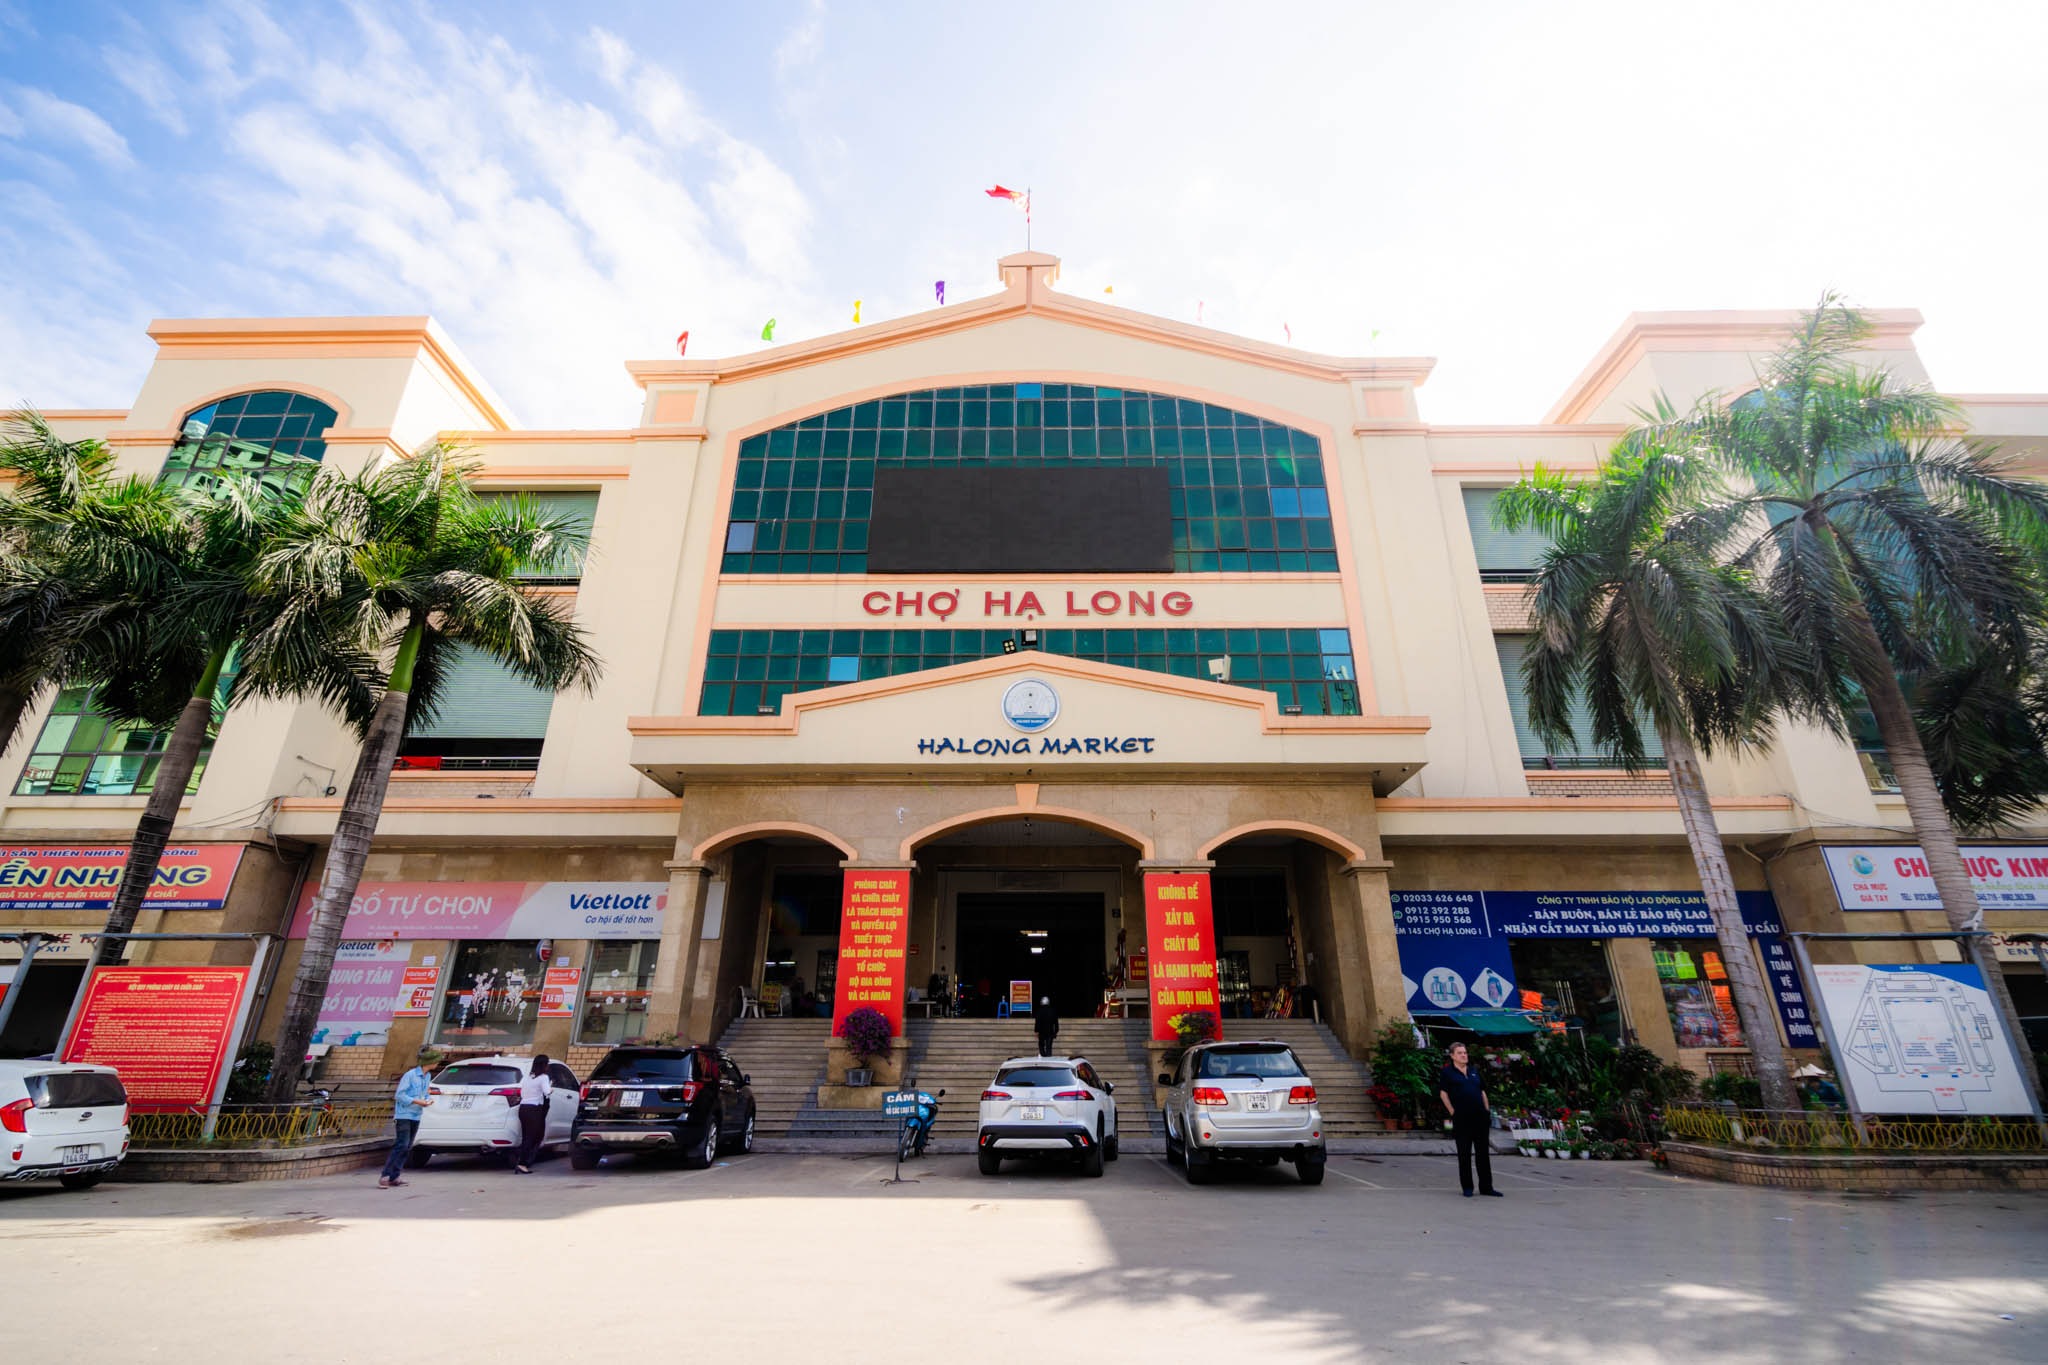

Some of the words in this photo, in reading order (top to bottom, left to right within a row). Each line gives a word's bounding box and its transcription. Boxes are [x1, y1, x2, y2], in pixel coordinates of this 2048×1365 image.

[862, 588, 960, 622] CHỢ
[984, 590, 1046, 621] HẠ
[1066, 590, 1193, 617] LONG
[917, 737, 1031, 755] HALONG
[1040, 737, 1155, 755] MARKET
[42, 848, 80, 857] THIÊN
[82, 848, 126, 857] NHIÊN
[53, 864, 212, 888] NHNG
[1893, 857, 1933, 878] CH
[1962, 855, 2004, 882] ỰC
[1158, 883, 1187, 900] KHÔNG
[1403, 894, 1432, 902] 02033
[1435, 894, 1453, 902] 626
[1455, 894, 1474, 902] 648
[348, 888, 385, 915] SỐ
[387, 893, 423, 920] TỰ
[424, 896, 493, 919] CHỌN
[569, 893, 652, 910] Vietlott
[1536, 895, 1562, 904] CÔNG
[1601, 895, 1620, 904] BẢO
[1622, 895, 1634, 906] HỘ
[1655, 895, 1681, 906] ĐỘNG
[1405, 906, 1429, 914] 0912
[1431, 906, 1449, 914] 392
[1452, 906, 1470, 914] 288
[1534, 908, 1558, 919] BÁN
[1560, 908, 1596, 920] BUÔN,
[1597, 908, 1622, 919] BÁN
[1640, 908, 1664, 919] BẢO
[1666, 908, 1682, 921] HỘ
[1684, 911, 1708, 919] LAO
[1183, 911, 1196, 926] RA
[1423, 927, 1441, 936] CHỢ
[1442, 928, 1454, 936] HẠ
[1504, 922, 1538, 935] NHẬN
[1564, 924, 1589, 933] MAY
[1592, 921, 1617, 933] BẢO
[1619, 921, 1635, 936] HỘ
[1637, 924, 1660, 933] LAO
[1662, 921, 1695, 937] ĐỘNG
[1770, 945, 1784, 955] AN
[1153, 961, 1165, 978] LÀ
[1190, 961, 1214, 978] PHÚC
[1769, 959, 1793, 971] TOÀN
[365, 966, 393, 984] TÂM
[1780, 974, 1793, 988] VỆ
[1157, 986, 1176, 1005] CỦA
[1781, 992, 1803, 1002] SINH
[1787, 1008, 1805, 1018] LAO
[1788, 1022, 1814, 1037] ĐỘNG
[886, 1091, 915, 1103] CẤM
